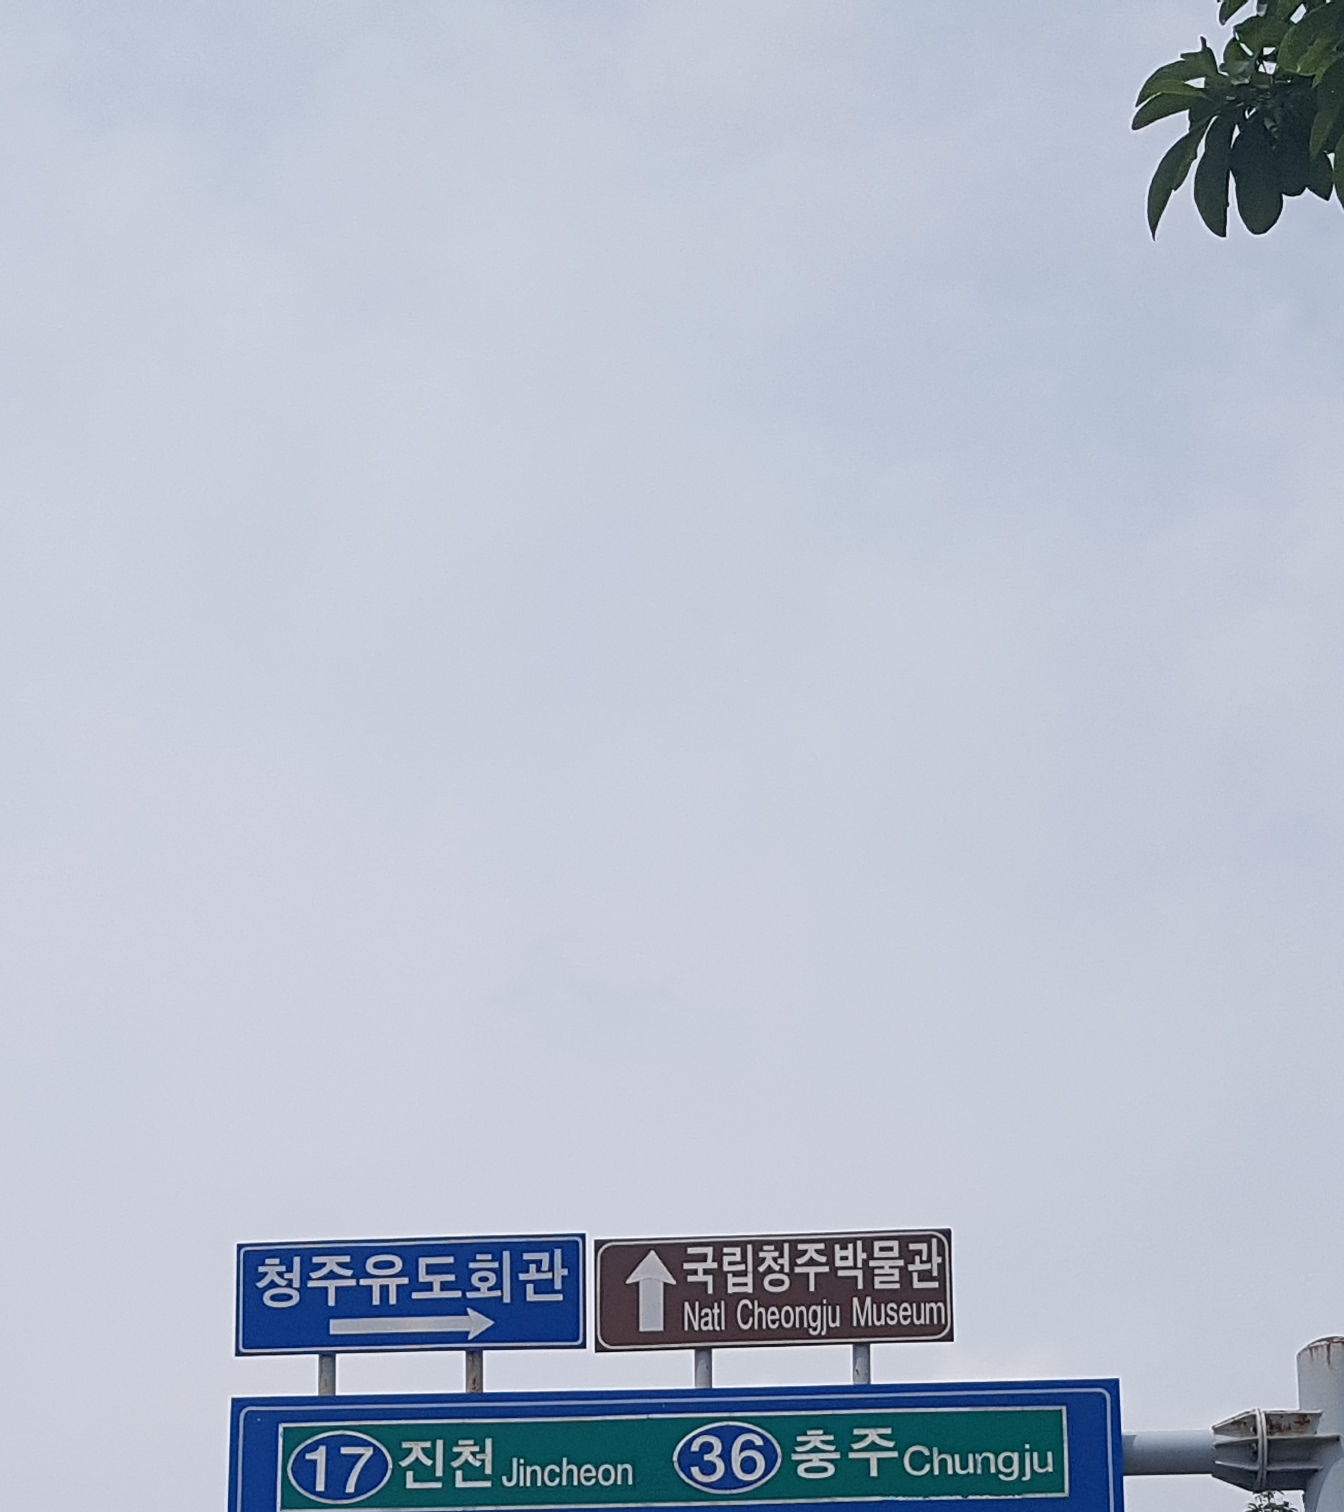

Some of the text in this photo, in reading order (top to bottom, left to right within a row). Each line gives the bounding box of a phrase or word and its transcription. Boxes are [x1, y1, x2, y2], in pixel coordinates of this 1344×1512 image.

[256, 1248, 569, 1309] 청주유도회관
[682, 1237, 943, 1295] 국립청주박물관
[683, 1295, 946, 1336] Natl Cheongju Museum
[304, 1437, 634, 1494] 17 진천 Jincheon
[689, 1426, 1054, 1483] 36 충주 Chungju
